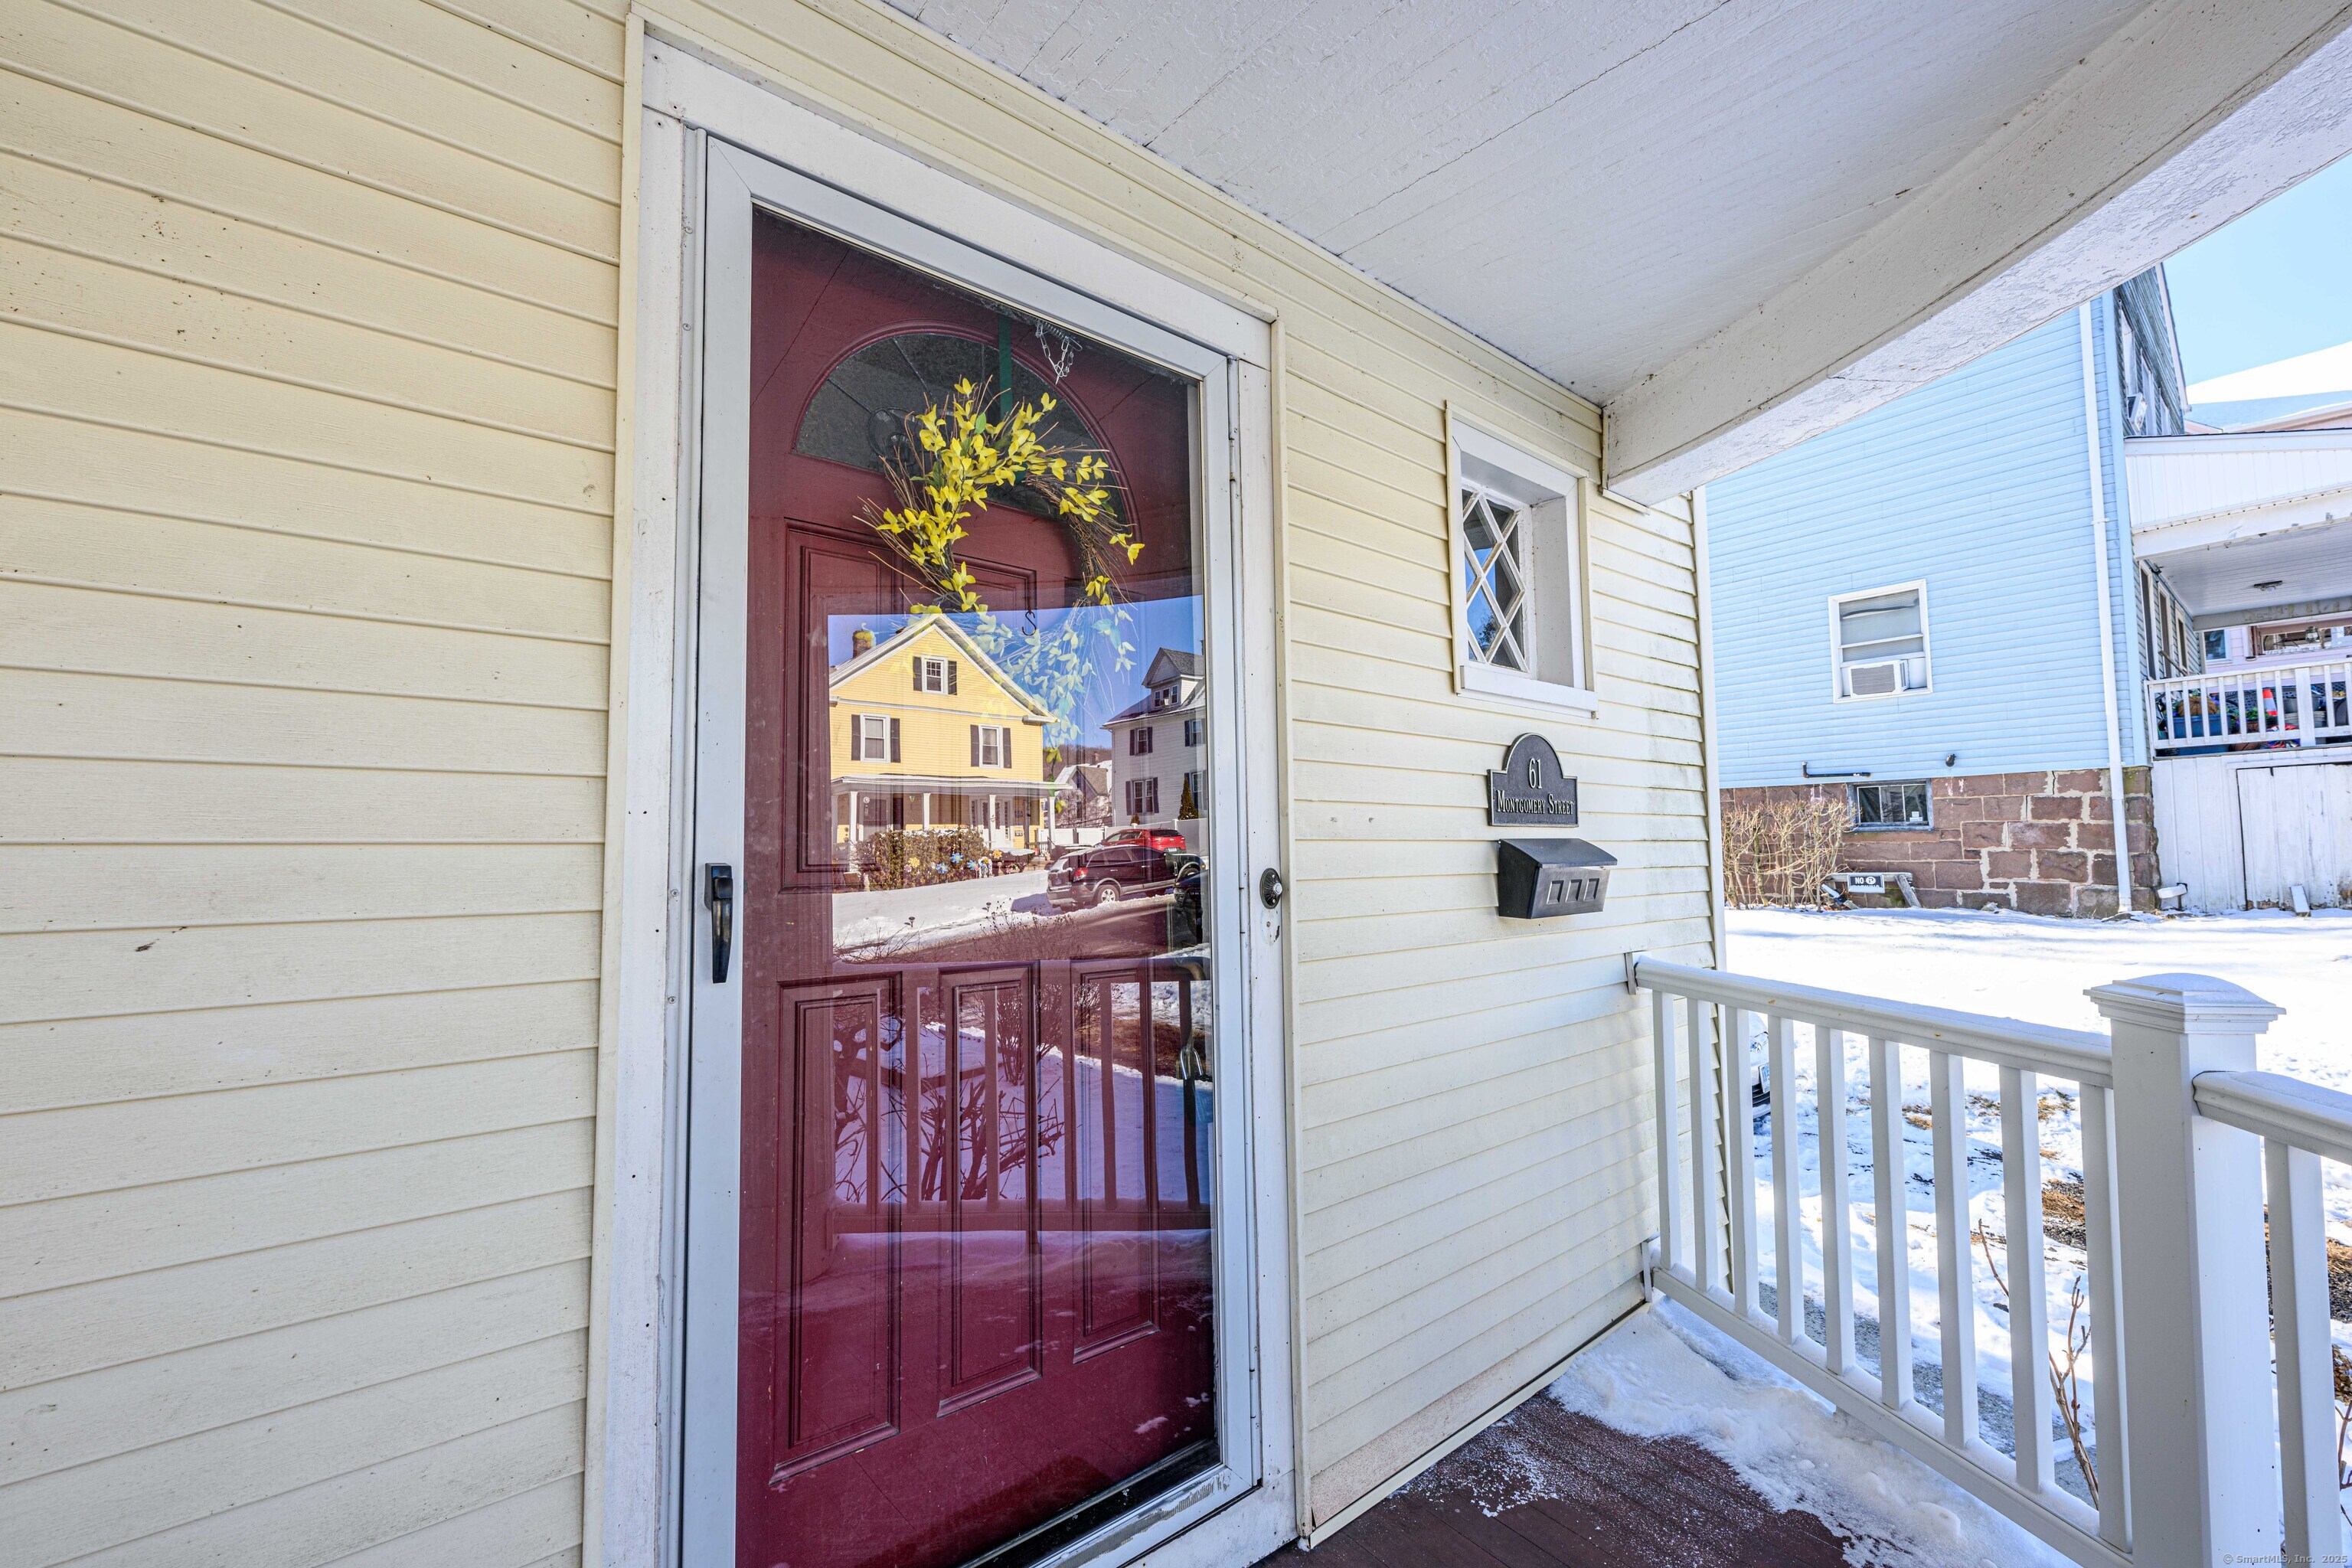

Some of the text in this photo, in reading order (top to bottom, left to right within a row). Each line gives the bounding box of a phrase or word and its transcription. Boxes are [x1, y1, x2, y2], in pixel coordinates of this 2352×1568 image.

[1529, 758, 1542, 789] 61
[1497, 790, 1574, 814] MONTGOMERY STREET
